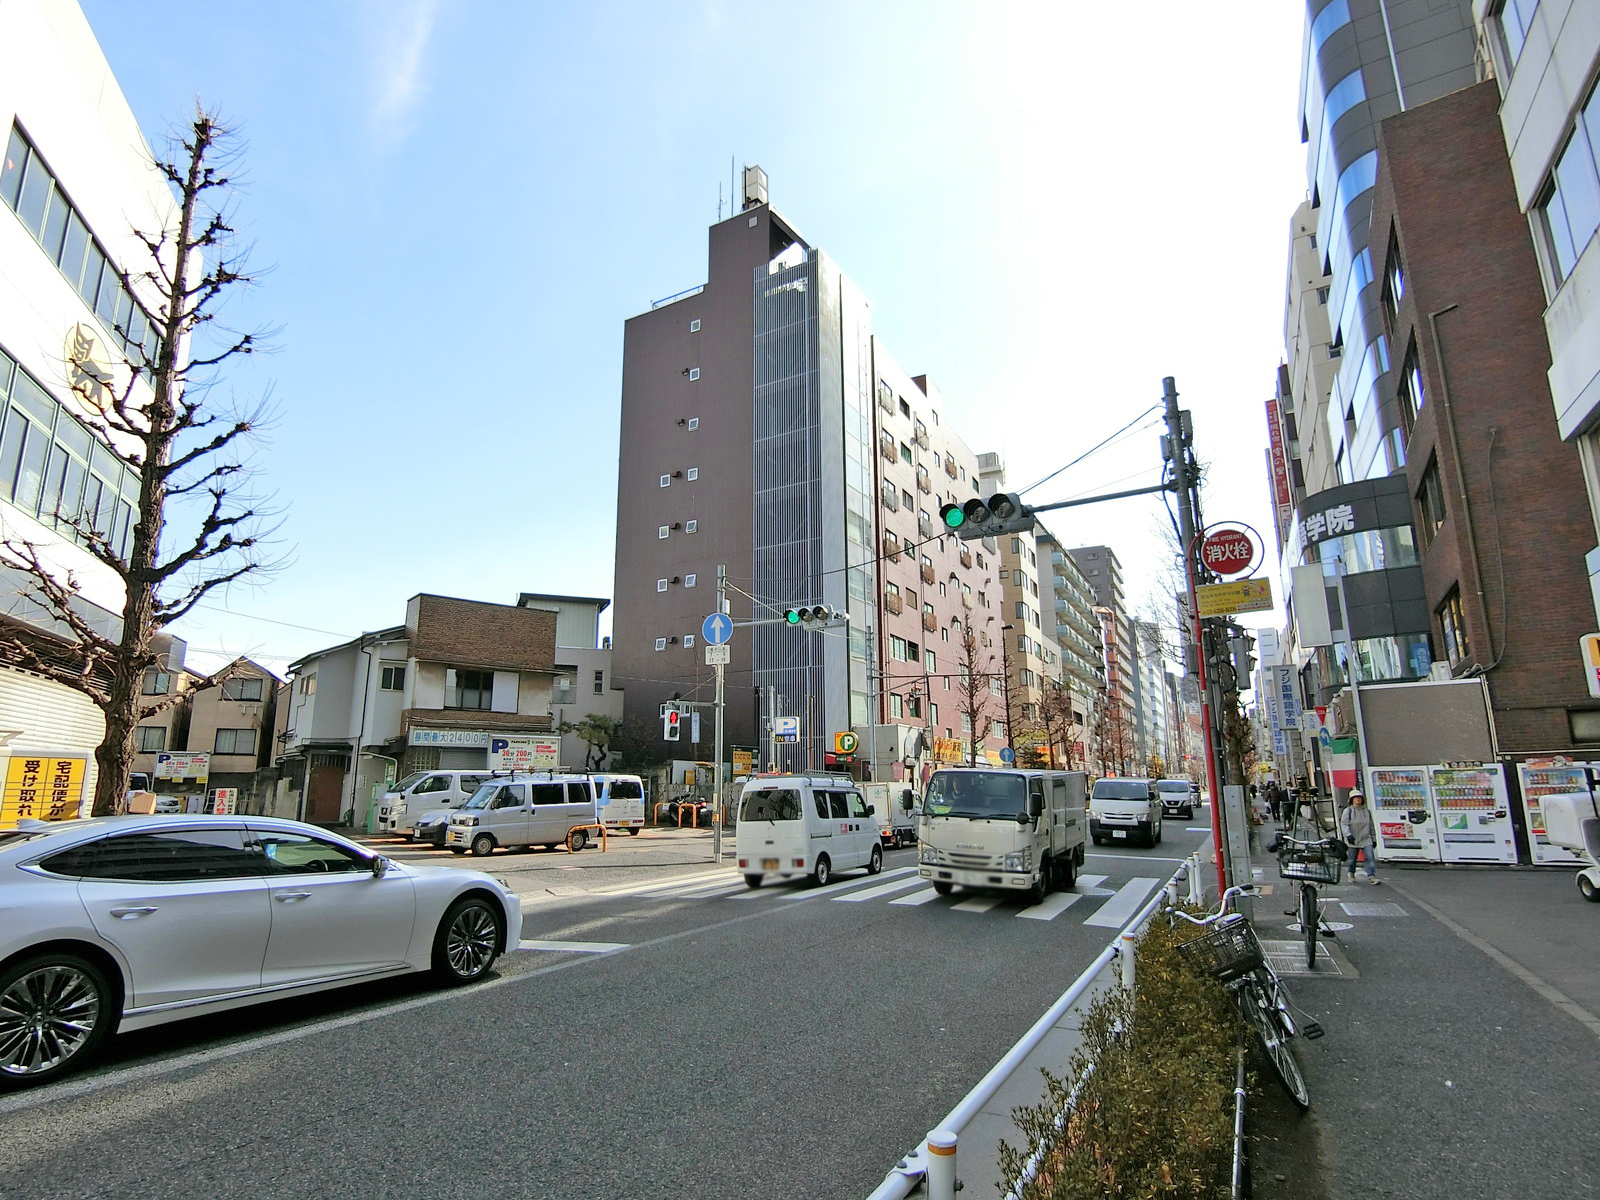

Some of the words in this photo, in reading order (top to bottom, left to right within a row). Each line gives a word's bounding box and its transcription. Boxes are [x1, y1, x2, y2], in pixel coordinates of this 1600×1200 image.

[1220, 533, 1242, 541] HYDRANT
[1206, 541, 1250, 563] 消火栓
[776, 718, 796, 734] P
[415, 731, 487, 744] 昼間最大2400円
[844, 735, 854, 749] P
[491, 739, 509, 753] P
[158, 755, 171, 763] P
[16, 760, 41, 826] 受け取れ
[49, 760, 73, 821] 宅配便が
